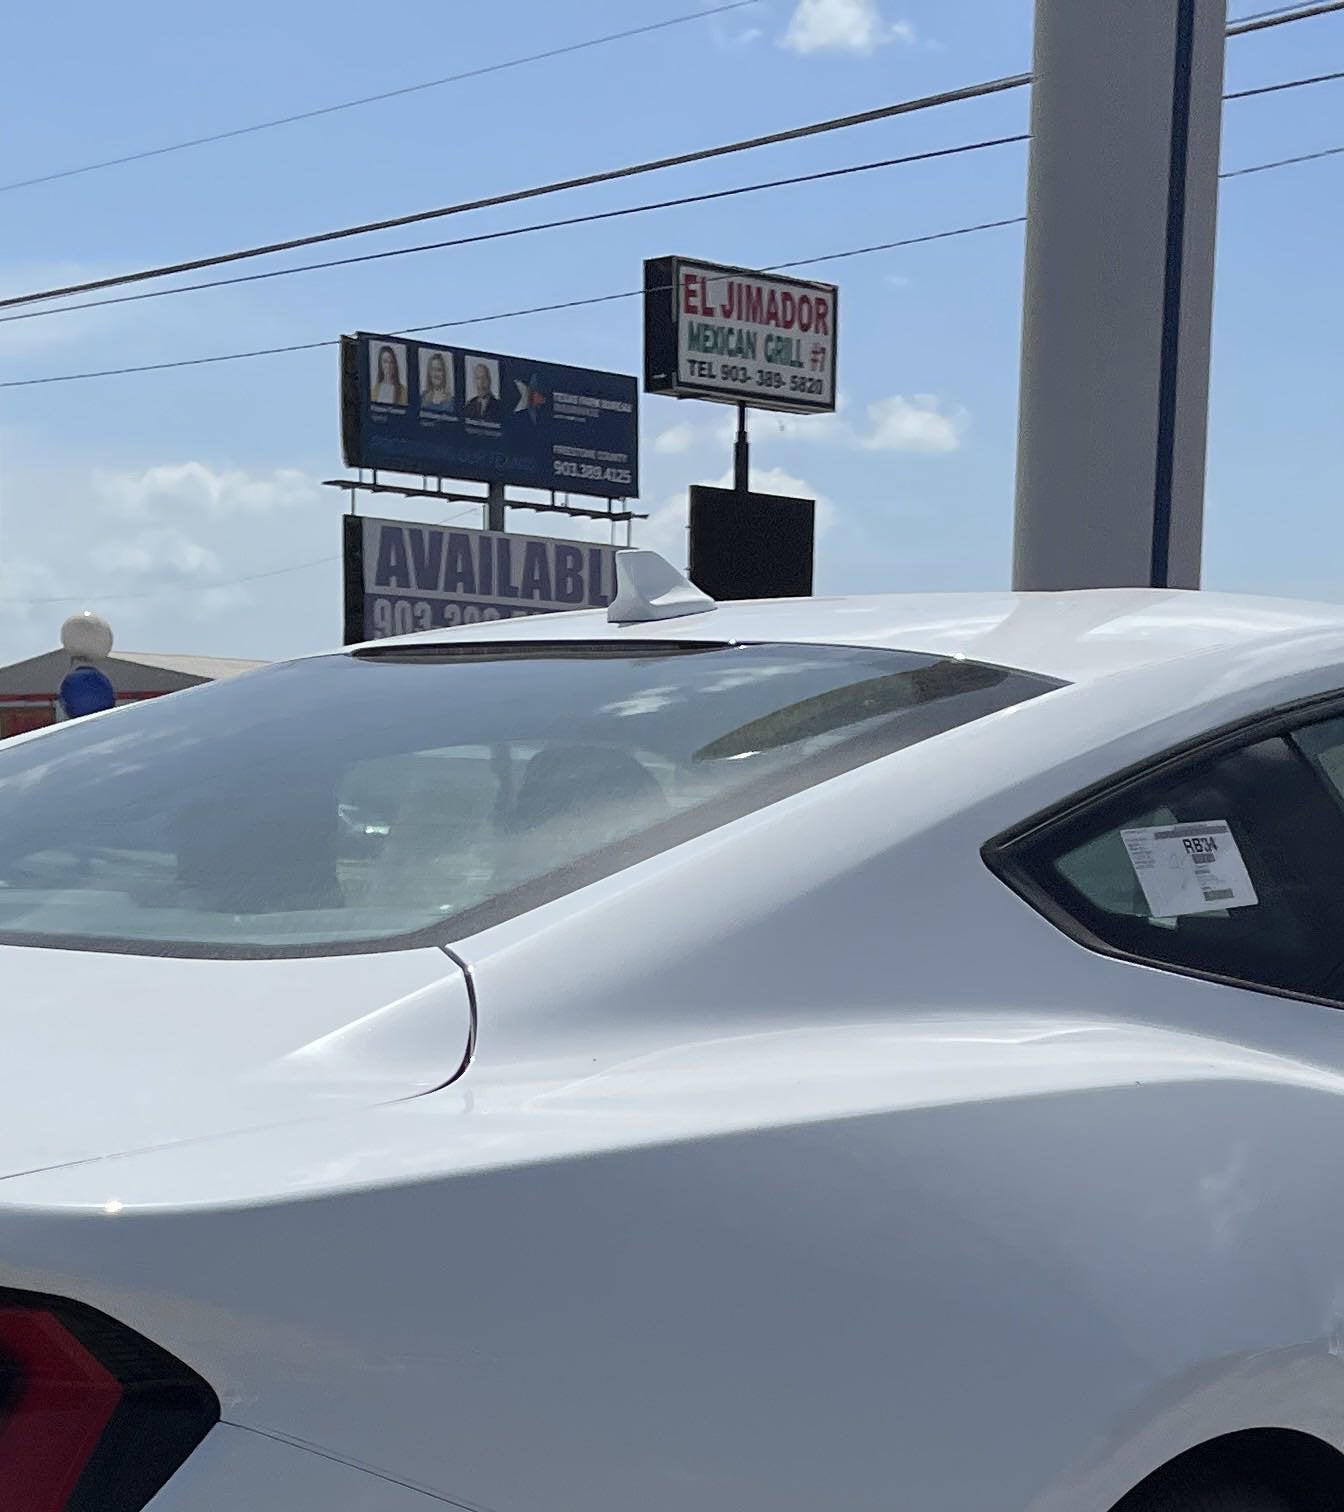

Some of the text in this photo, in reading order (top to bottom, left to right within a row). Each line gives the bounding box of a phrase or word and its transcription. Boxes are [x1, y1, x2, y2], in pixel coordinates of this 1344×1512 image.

[683, 273, 829, 336] EL JIMADOR
[688, 320, 804, 368] MEXICAN GRILL
[688, 359, 716, 379] TEL
[790, 374, 824, 395] 5820
[375, 526, 617, 608] AVAILABL
